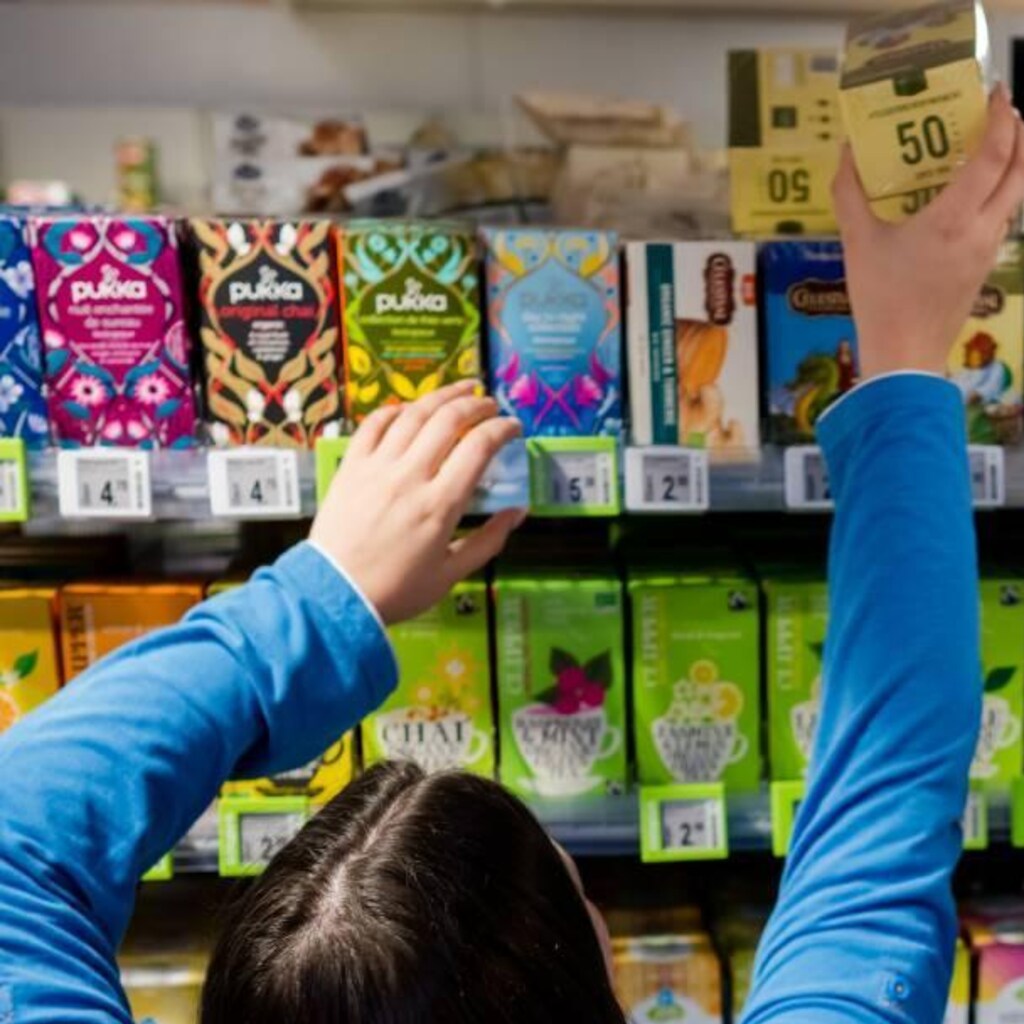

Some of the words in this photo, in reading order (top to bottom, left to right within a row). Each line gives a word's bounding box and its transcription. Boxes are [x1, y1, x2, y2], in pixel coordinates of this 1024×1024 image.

[896, 114, 949, 165] 50
[768, 168, 810, 203] 50
[71, 278, 147, 303] pukka
[229, 279, 303, 304] pukka
[375, 291, 448, 314] pukka
[100, 481, 113, 504] 4
[250, 480, 263, 503] 4
[662, 476, 676, 500] 2
[680, 822, 693, 845] 2
